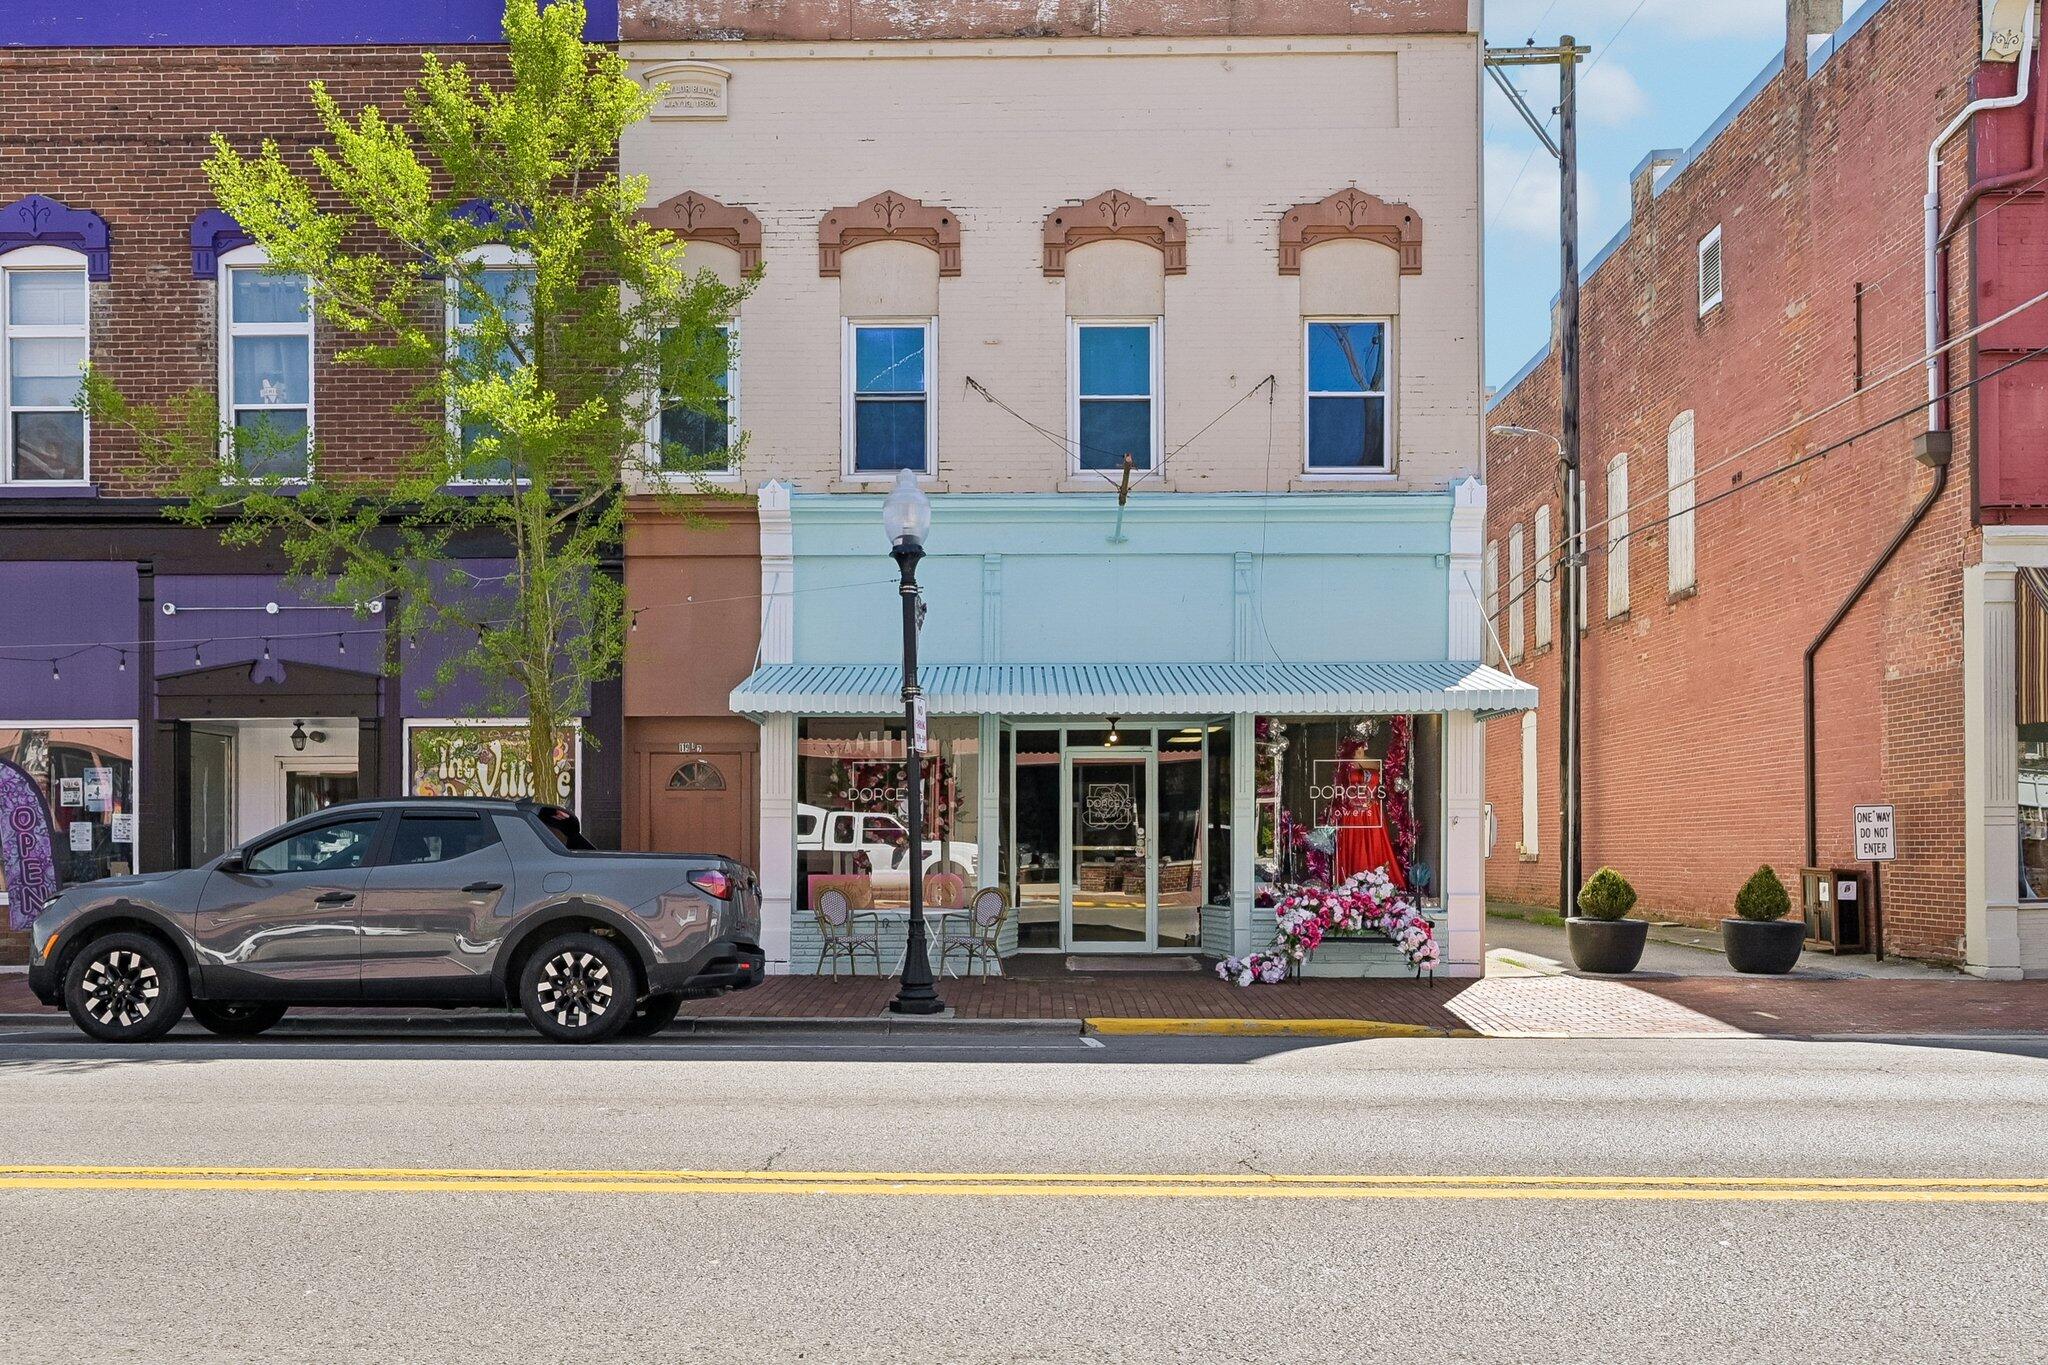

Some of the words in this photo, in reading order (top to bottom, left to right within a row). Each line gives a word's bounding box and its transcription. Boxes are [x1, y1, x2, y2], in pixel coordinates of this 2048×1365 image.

[664, 100, 682, 108] MAY
[476, 739, 571, 798] Villae
[1309, 785, 1387, 799] DORCEYS
[1857, 812, 1873, 823] ONE
[1875, 811, 1891, 823] WAY
[1860, 827, 1871, 839] DO
[1873, 827, 1889, 838] NOT
[1863, 842, 1887, 854] ENTER
[11, 805, 48, 913] OPEN
